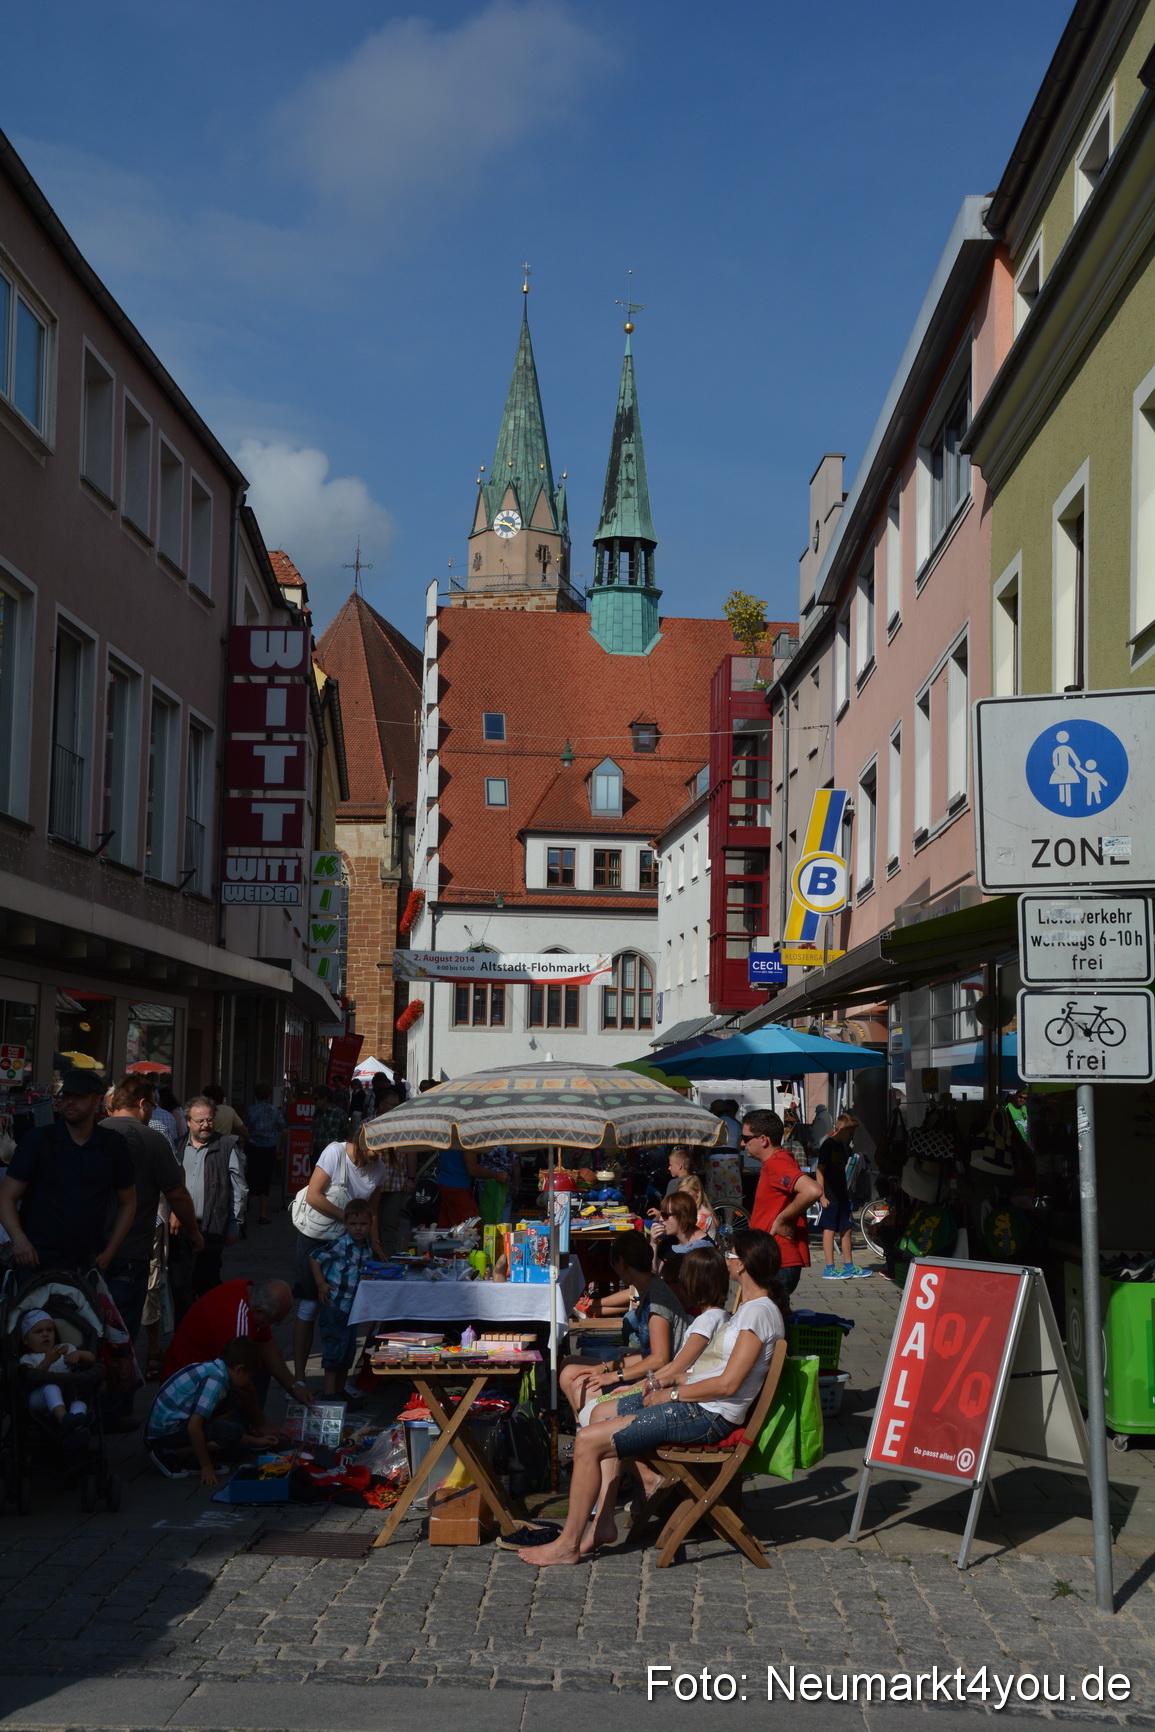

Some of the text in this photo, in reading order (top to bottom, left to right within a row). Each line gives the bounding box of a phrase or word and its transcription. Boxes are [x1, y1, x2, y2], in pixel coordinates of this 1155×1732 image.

[250, 630, 303, 842] WITT
[226, 857, 298, 881] WITT
[807, 866, 838, 896] B
[311, 855, 340, 978] KIWI
[1038, 908, 1132, 924] Leerverkehr
[1031, 934, 1095, 951] wetags
[423, 954, 453, 964] August
[454, 955, 475, 963] 2014
[785, 953, 836, 962] KLOSTERGASE
[1072, 954, 1103, 970] frei
[480, 961, 591, 973] Altstadt-Flohmarkt
[752, 961, 783, 971] CECIL
[1066, 1050, 1106, 1071] frei
[296, 1103, 316, 1117] WI
[882, 1272, 939, 1458] SALE
[913, 1446, 956, 1462] Da passt alles!
